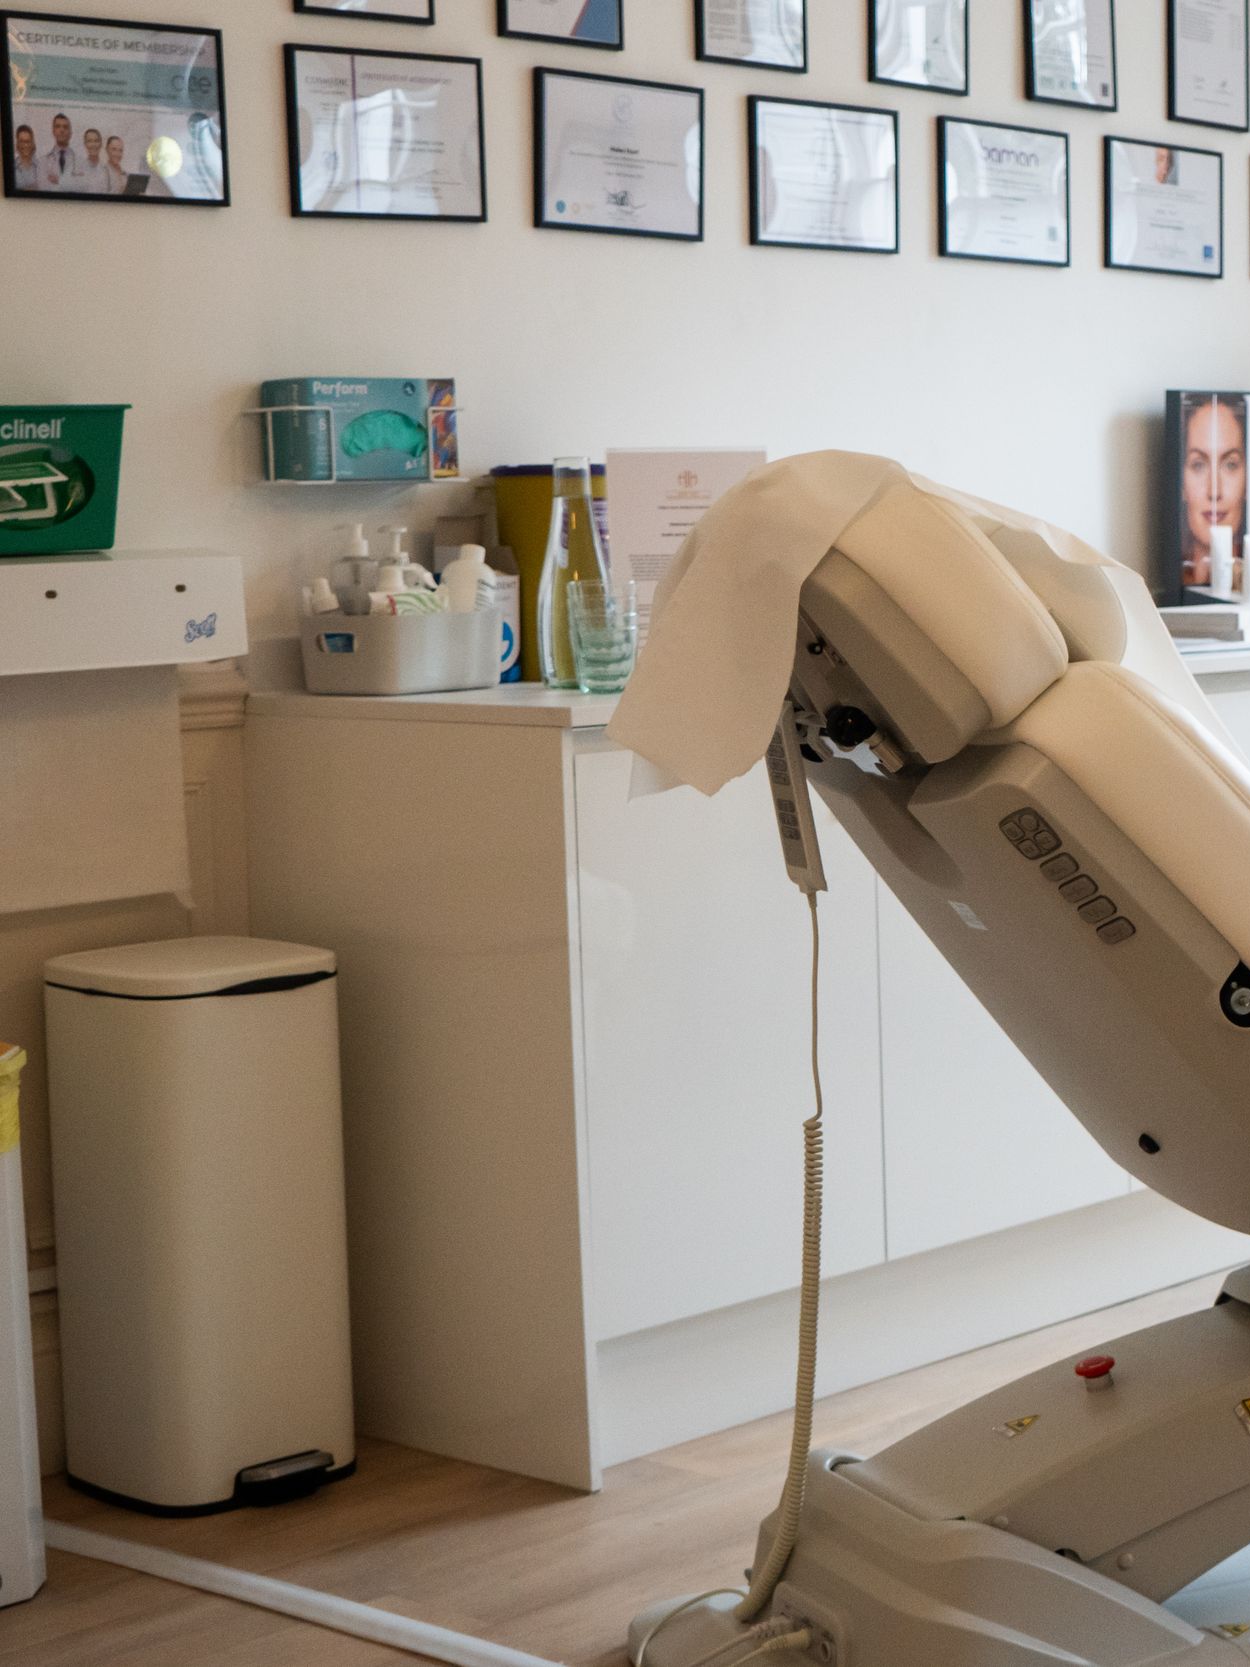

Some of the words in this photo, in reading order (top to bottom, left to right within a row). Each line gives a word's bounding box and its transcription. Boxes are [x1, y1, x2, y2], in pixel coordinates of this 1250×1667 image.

[17, 31, 100, 49] CERTIFICATE
[103, 38, 120, 50] OF
[312, 380, 368, 398] Perform
[0, 418, 61, 440] clinell
